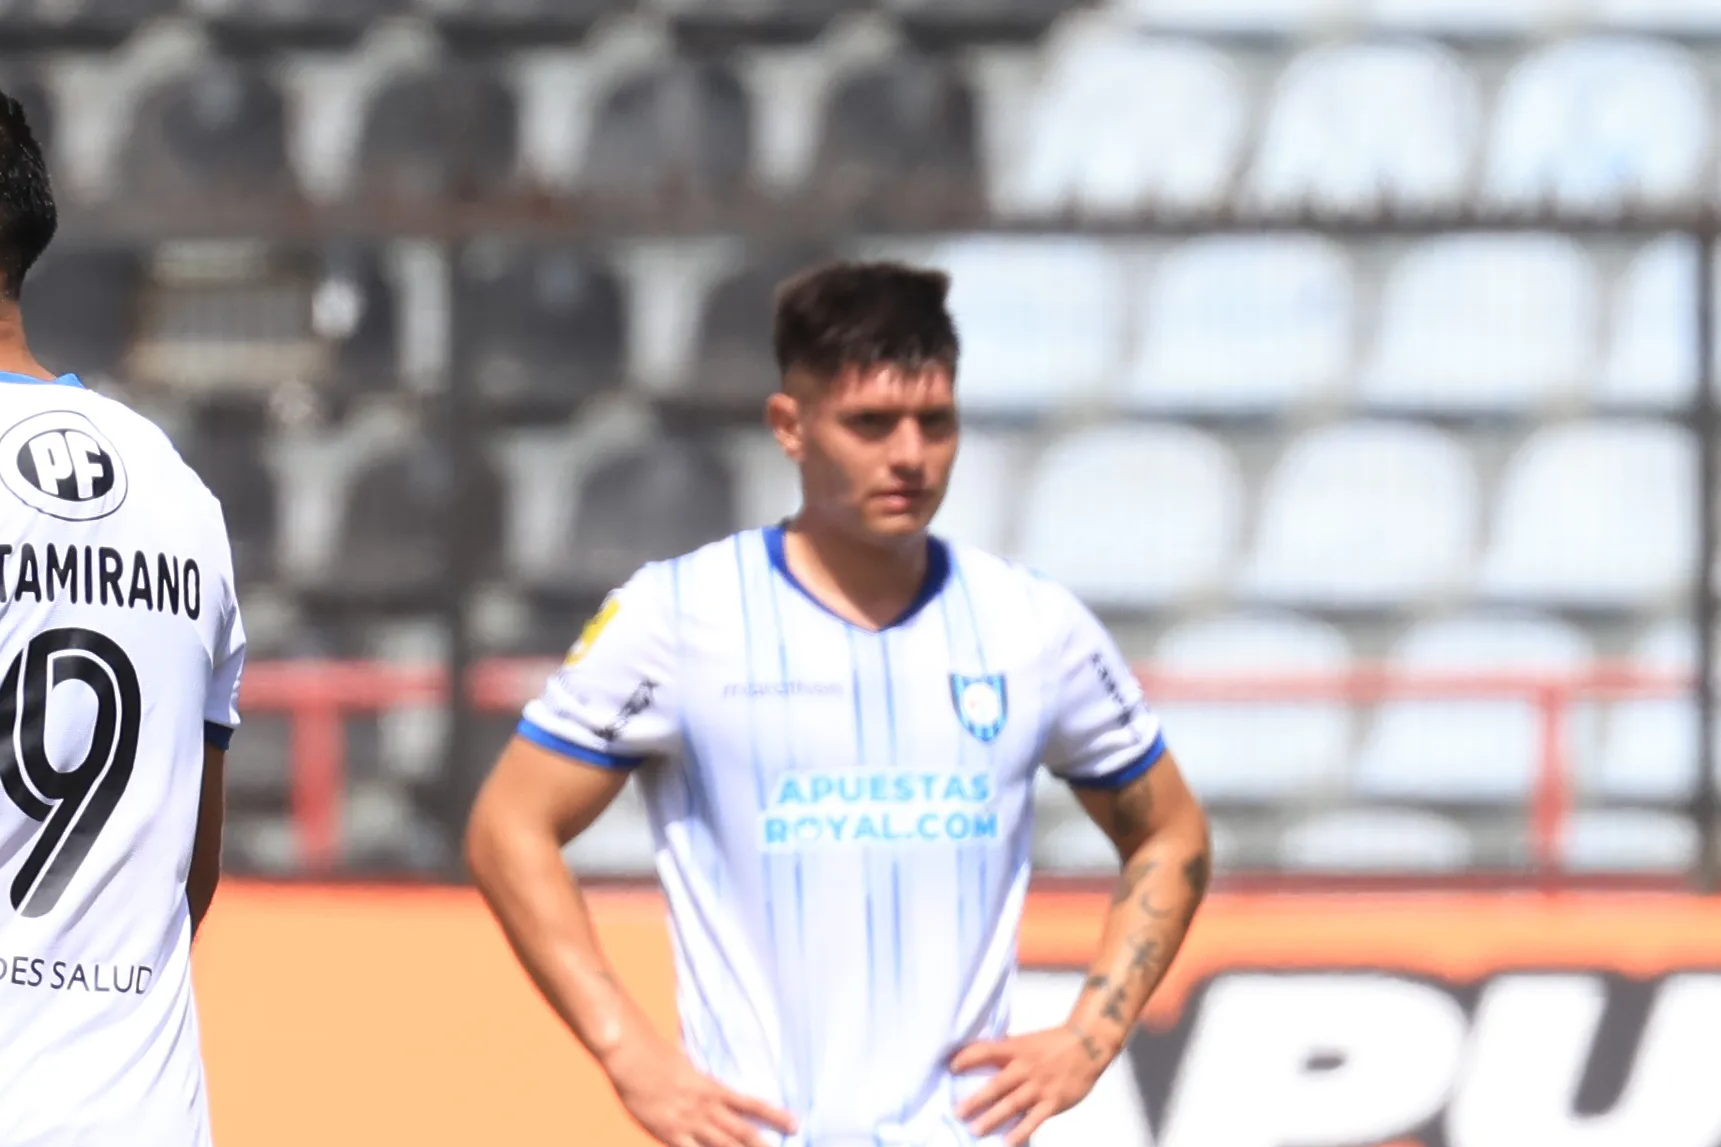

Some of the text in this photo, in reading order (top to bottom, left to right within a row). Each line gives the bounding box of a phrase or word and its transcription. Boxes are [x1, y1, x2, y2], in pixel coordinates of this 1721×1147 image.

[17, 428, 116, 501] PF
[779, 772, 990, 804] APUESTAS
[764, 812, 998, 843] ROYAL.COM
[50, 961, 153, 995] SALUD
